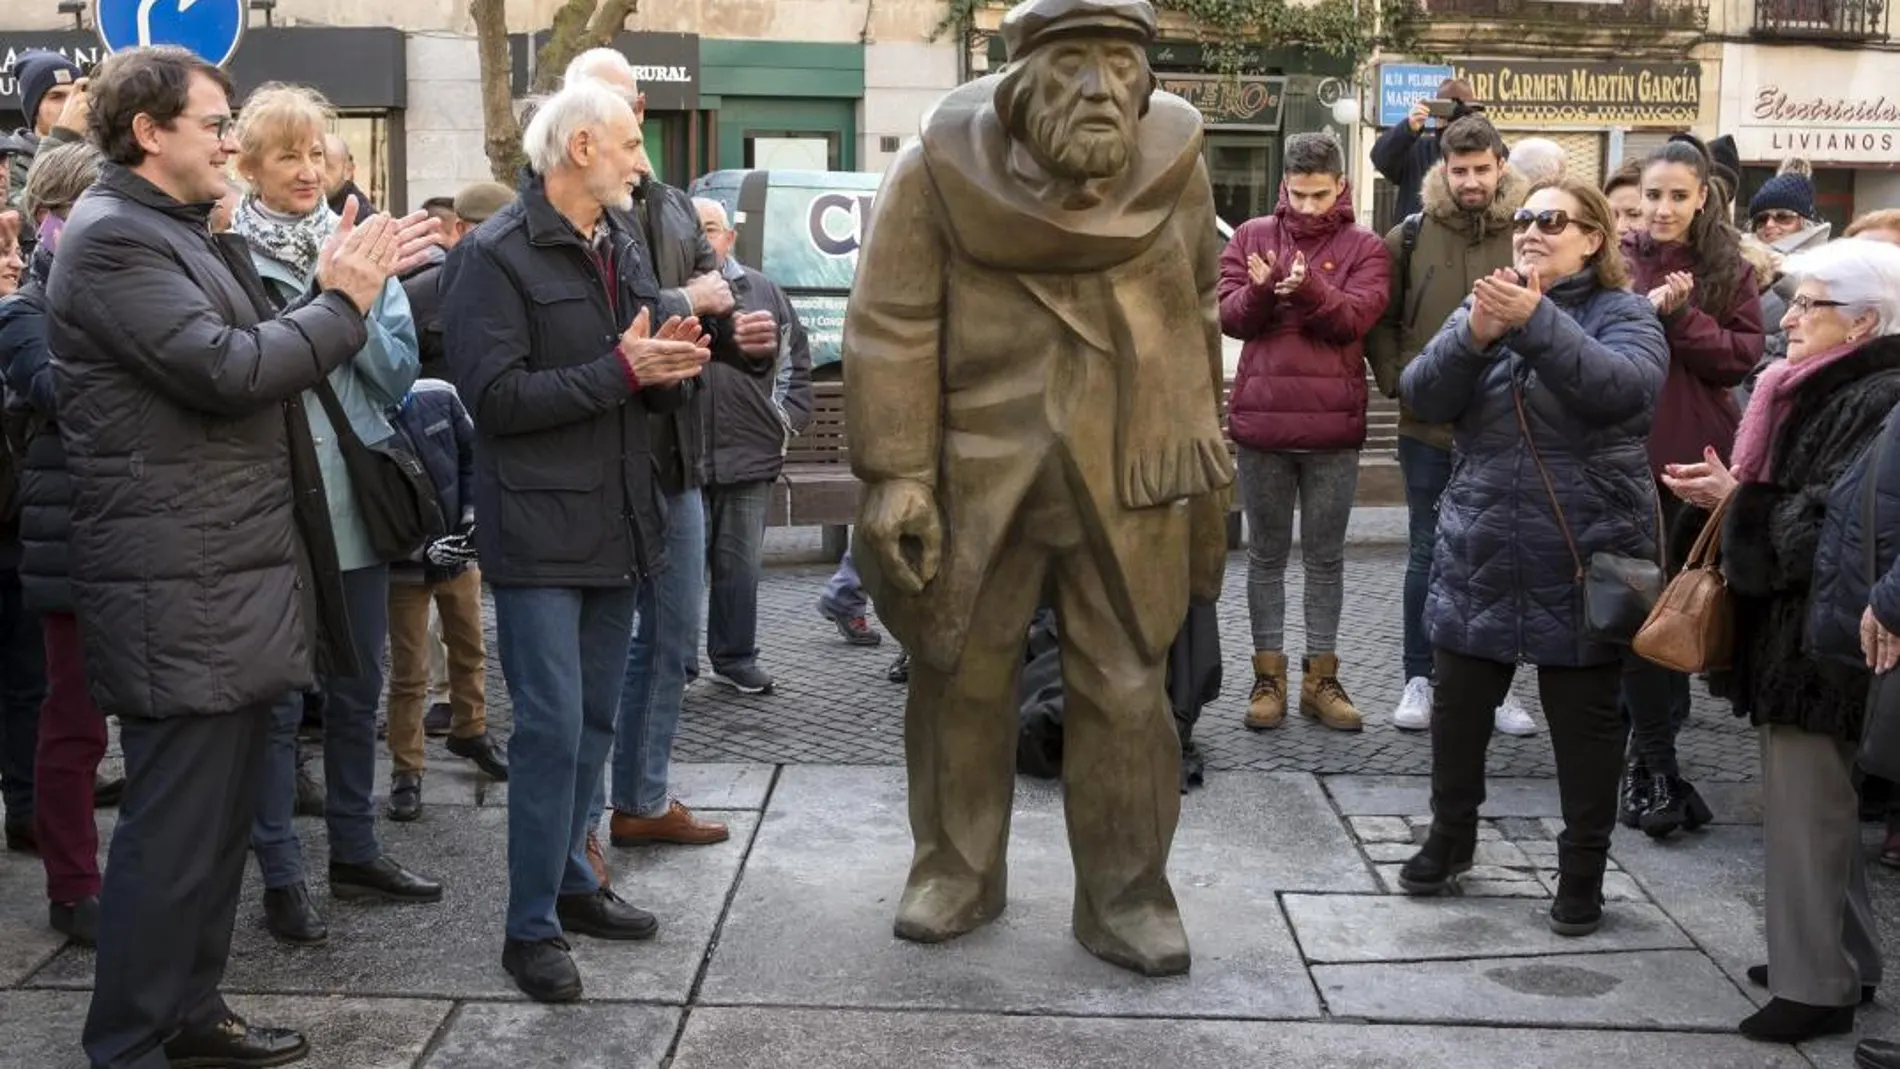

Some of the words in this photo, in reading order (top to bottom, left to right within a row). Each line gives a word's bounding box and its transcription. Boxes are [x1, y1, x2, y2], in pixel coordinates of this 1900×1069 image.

[631, 65, 692, 82] RURAL
[1499, 67, 1568, 101] CARMEN
[1571, 66, 1634, 102] MARTÍN
[1638, 67, 1698, 103] GARCÍA
[1484, 105, 1589, 120] BUTIDOS
[1753, 86, 1900, 121] Electricida
[1772, 133, 1893, 151] LIVIANOS
